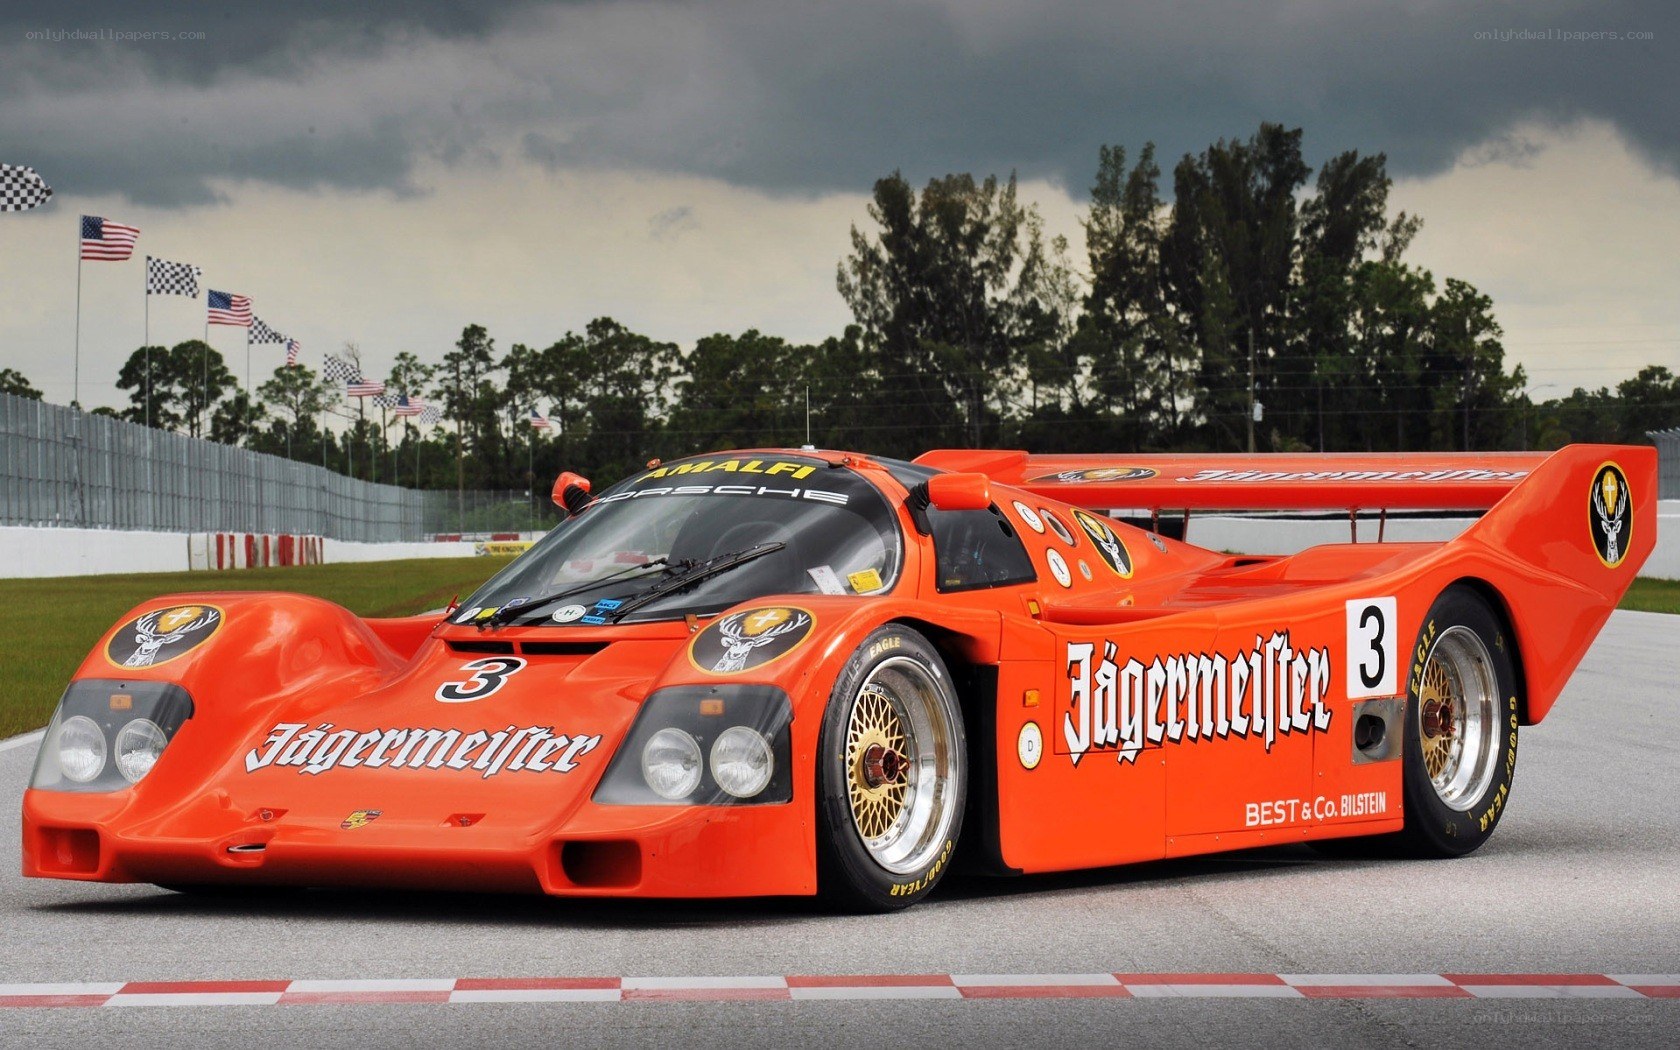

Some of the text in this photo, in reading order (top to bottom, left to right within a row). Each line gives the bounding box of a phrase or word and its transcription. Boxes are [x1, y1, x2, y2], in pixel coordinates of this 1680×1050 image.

[634, 460, 817, 483] AMALFI
[869, 636, 901, 659] EAGLE
[1359, 605, 1385, 688] 3
[1411, 619, 1436, 697] EAGLE
[434, 656, 528, 703] 3
[1245, 799, 1300, 827] BEST
[1301, 802, 1312, 820] &
[1340, 792, 1386, 817] BILSTEIN
